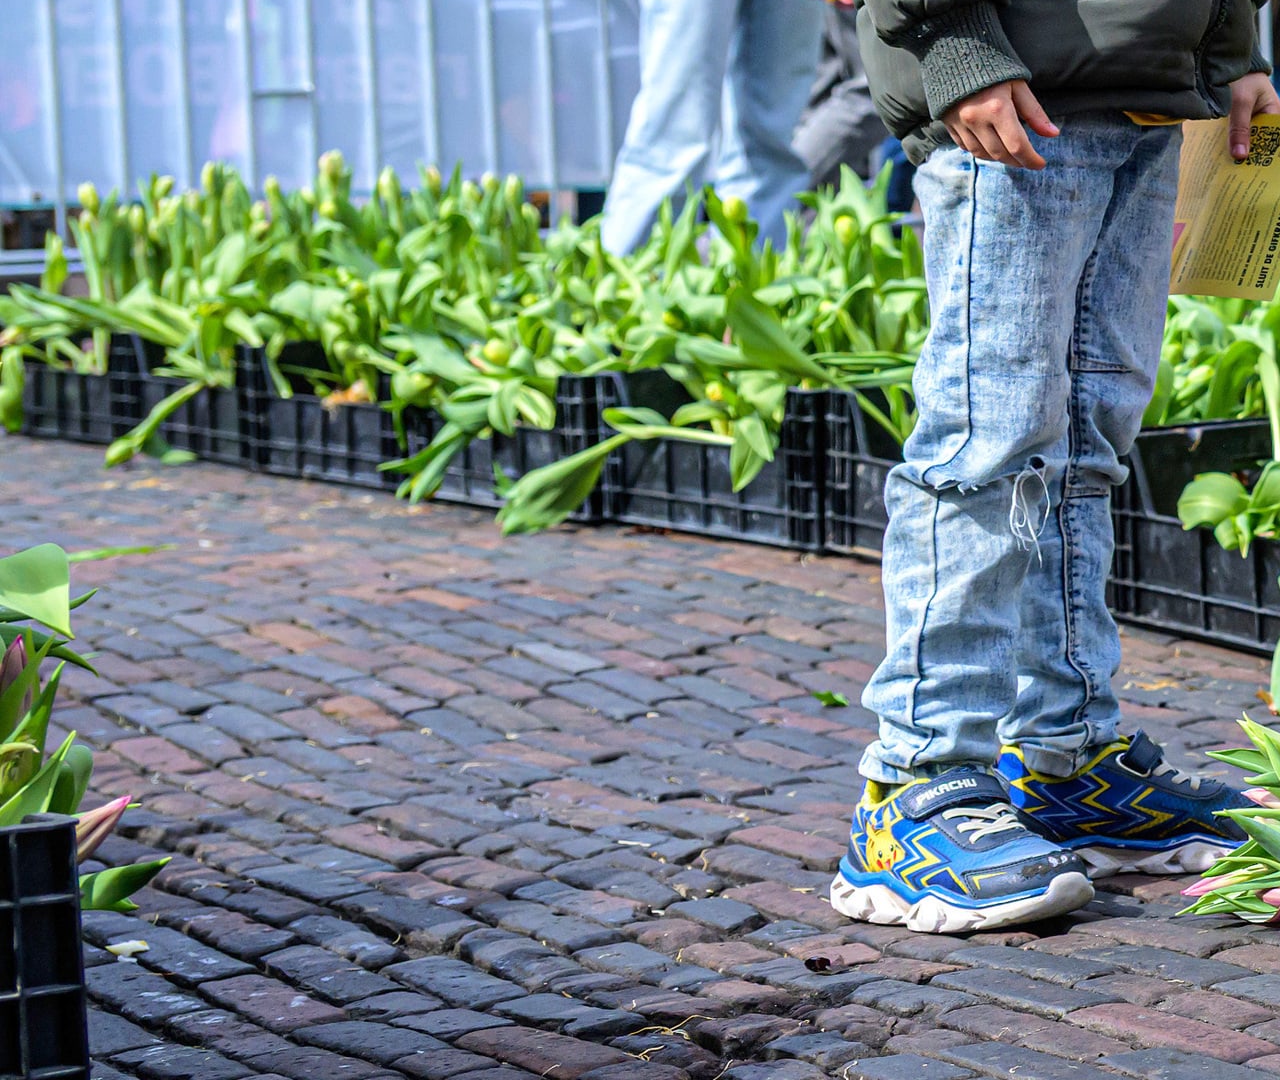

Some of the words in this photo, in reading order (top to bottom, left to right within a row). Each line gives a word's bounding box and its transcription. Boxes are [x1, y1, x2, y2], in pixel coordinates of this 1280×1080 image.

[1255, 266, 1270, 289] SLUIT
[1263, 253, 1274, 264] DE
[915, 778, 978, 806] PIKACHU
